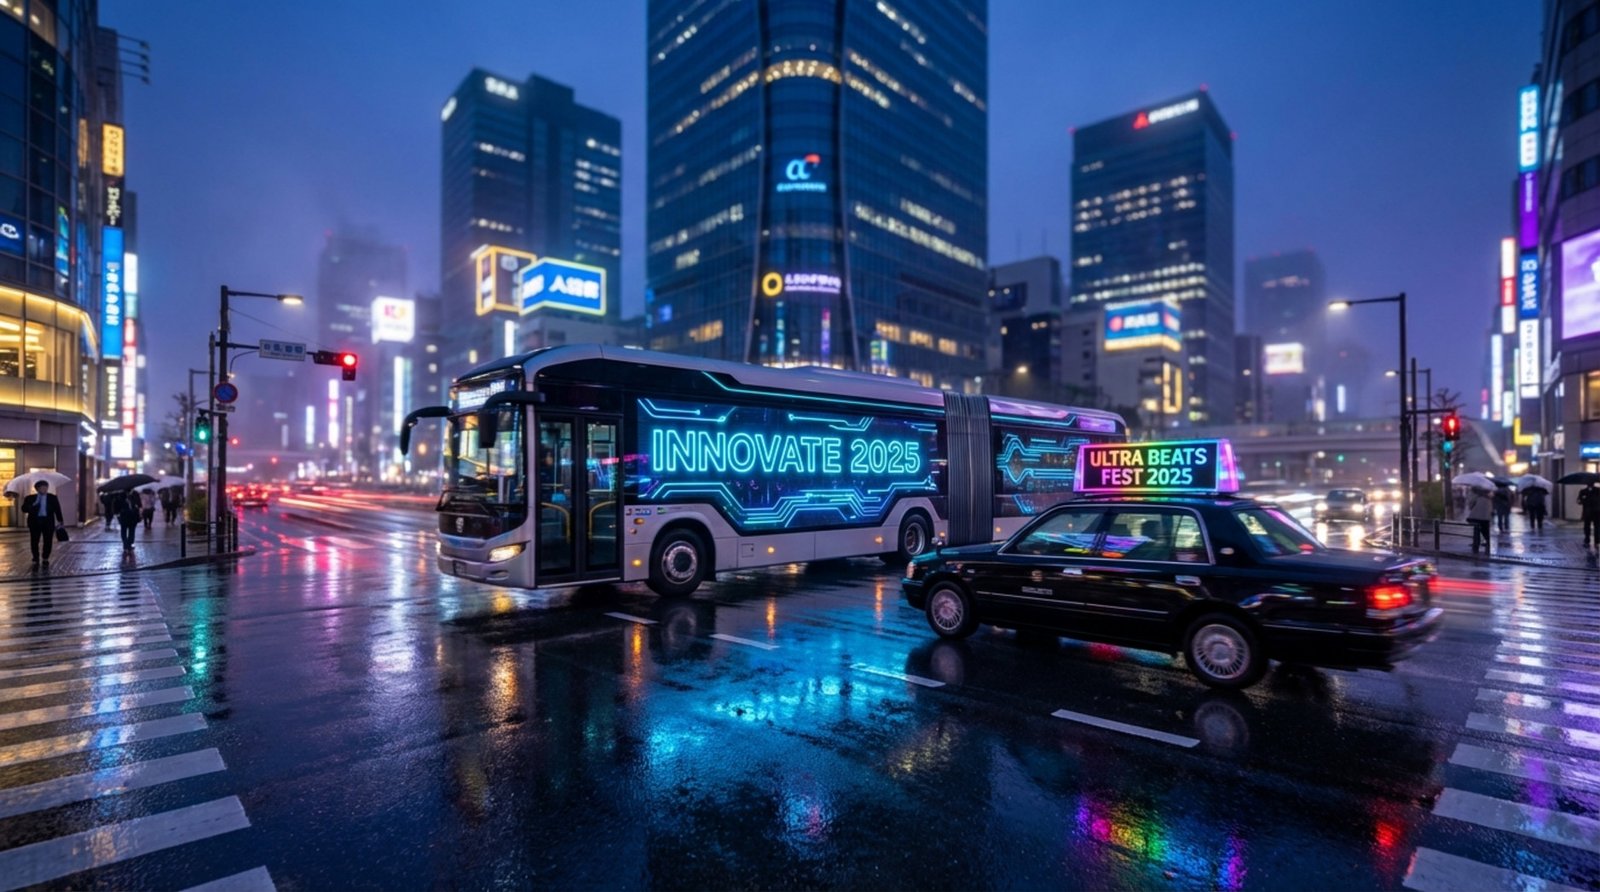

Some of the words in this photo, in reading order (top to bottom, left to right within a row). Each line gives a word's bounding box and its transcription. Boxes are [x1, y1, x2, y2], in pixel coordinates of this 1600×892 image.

[651, 428, 842, 473] INNOVATE
[849, 438, 922, 474] 2025
[1089, 449, 1144, 467] ULTRA
[1147, 447, 1208, 466] BEATS
[1101, 468, 1144, 485] FEST
[1146, 467, 1193, 485] 2025
